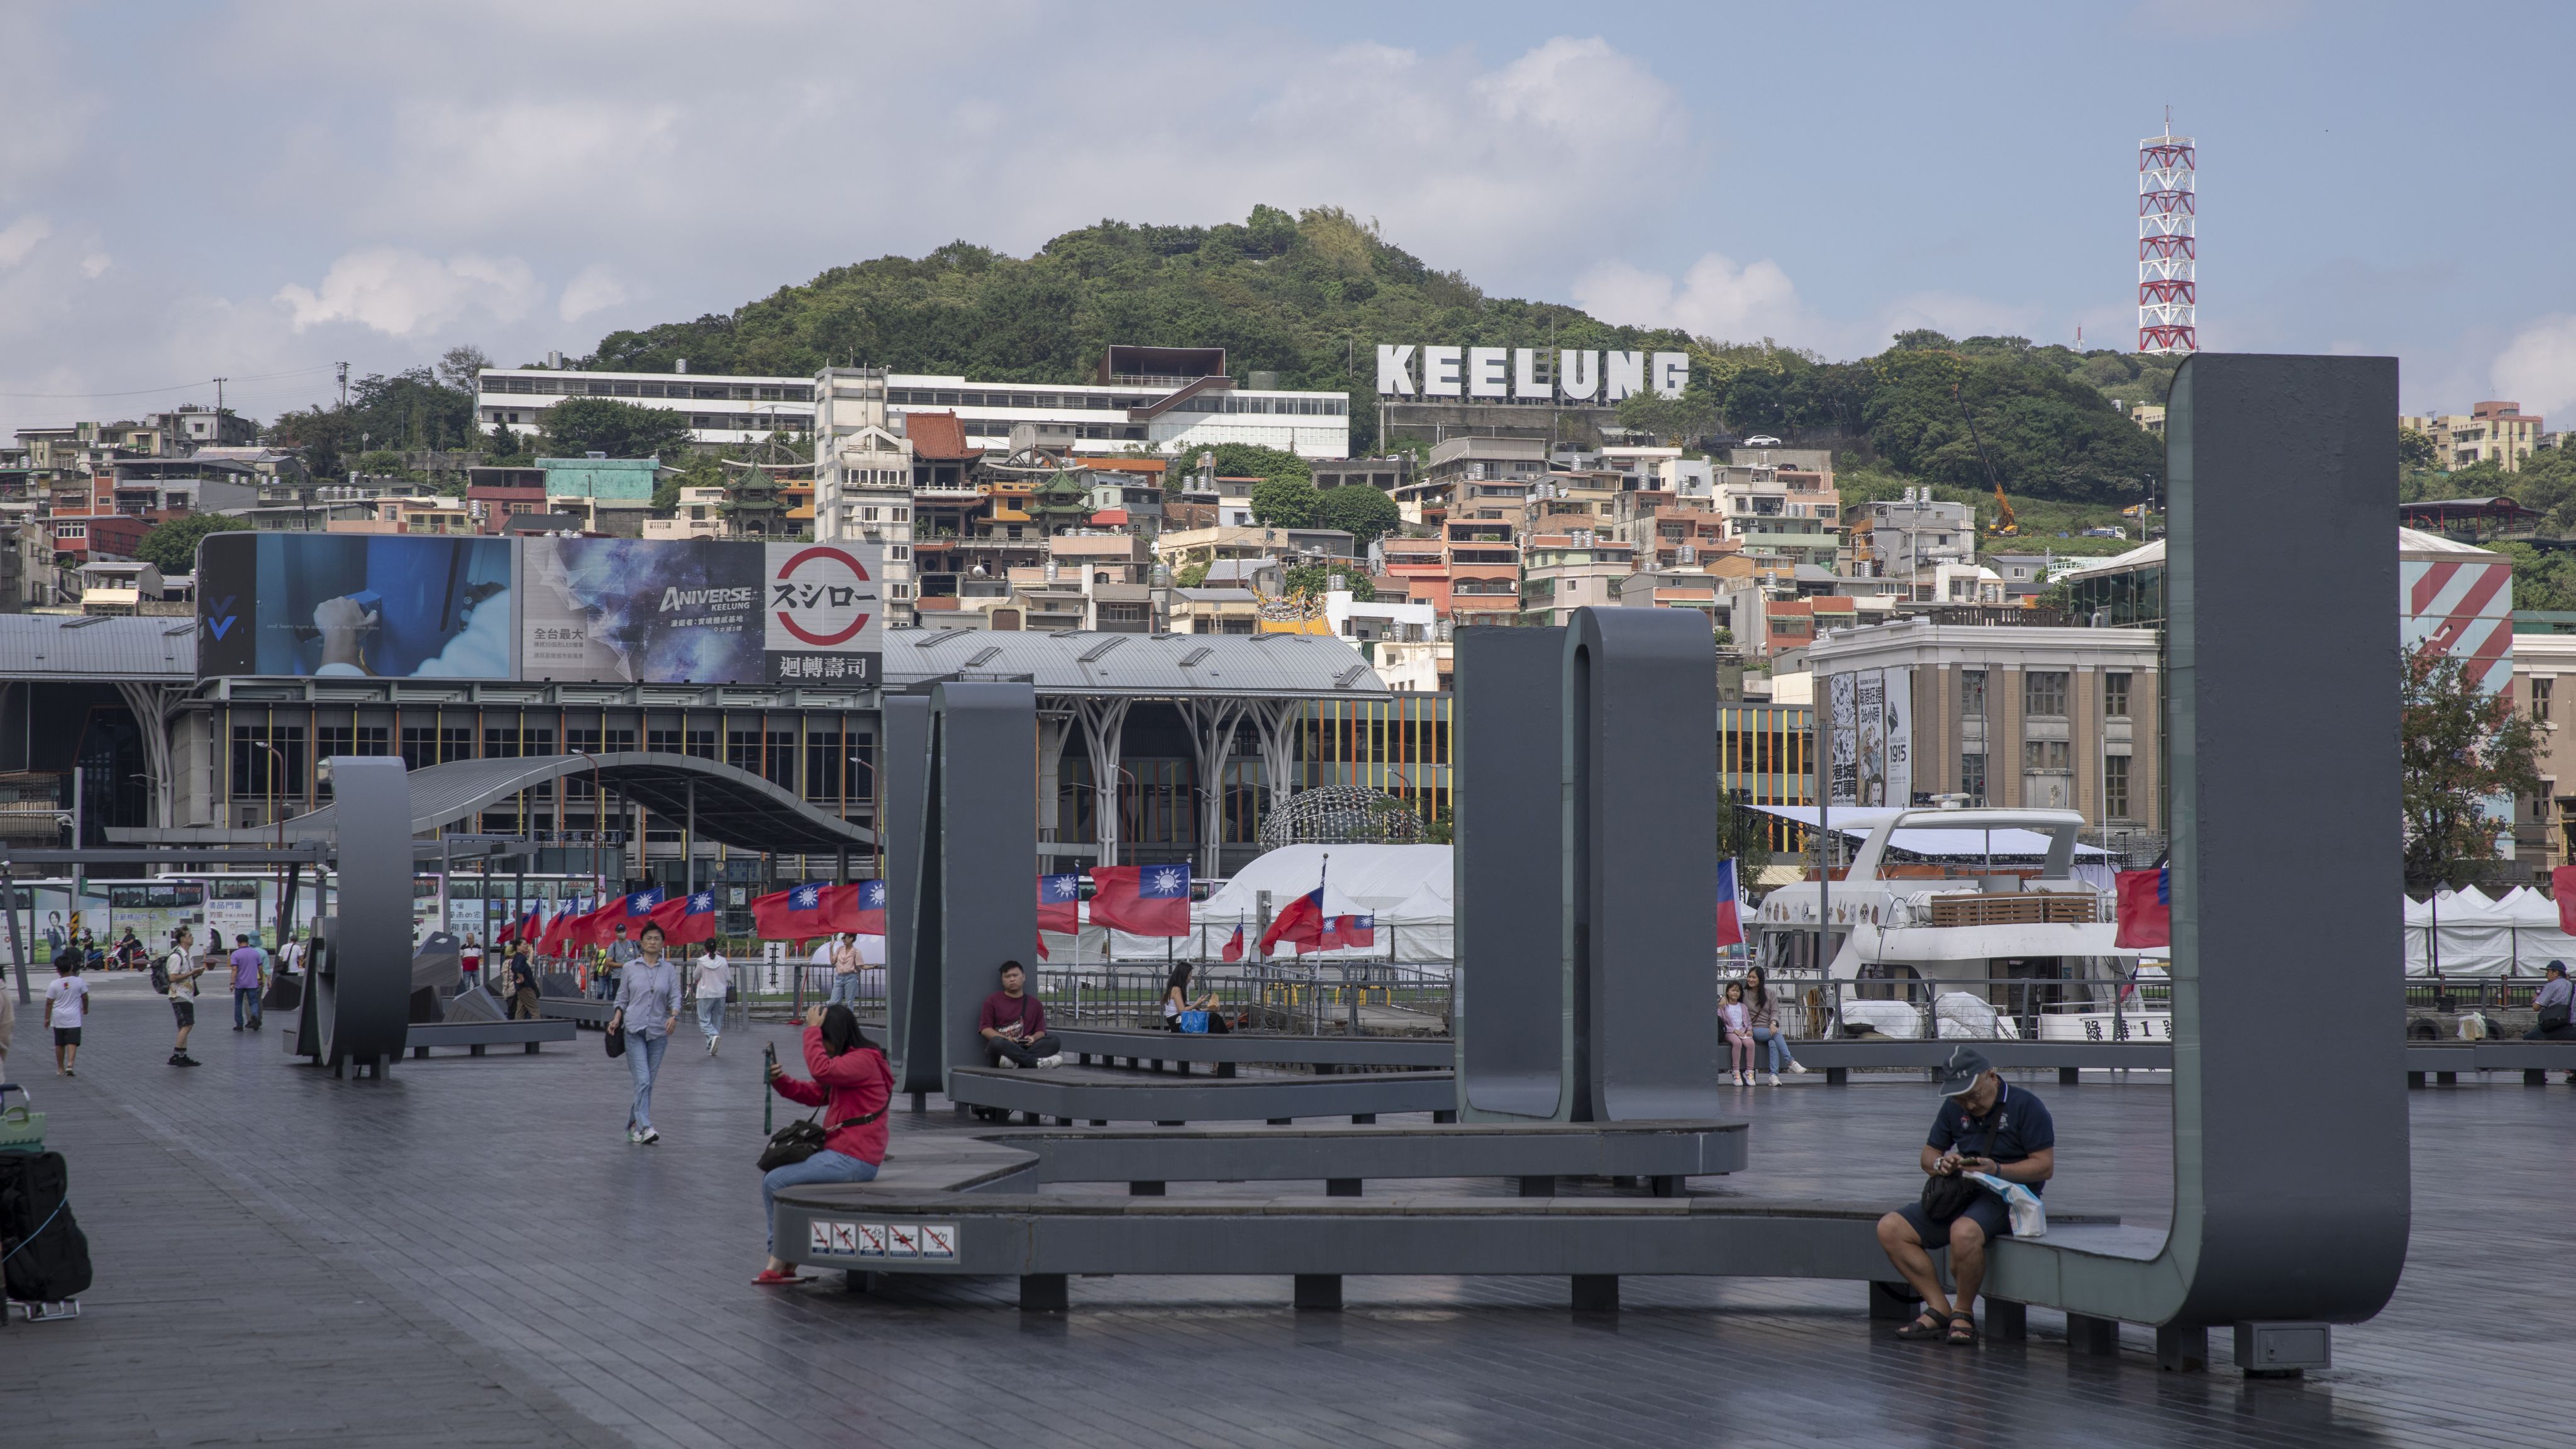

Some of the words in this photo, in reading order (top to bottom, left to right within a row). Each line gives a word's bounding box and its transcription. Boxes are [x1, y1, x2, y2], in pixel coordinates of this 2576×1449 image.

[1377, 344, 1690, 399] KEELUNG
[658, 586, 752, 612] ANIVERSE
[770, 583, 877, 609] スシロー
[711, 602, 750, 611] KEELUNG
[534, 628, 584, 640] 全台最大
[780, 656, 867, 678] 迴轉壽司
[1858, 686, 1882, 706] 海港狂搜
[1861, 706, 1880, 724] 26小時
[1890, 745, 1906, 763] 1915
[1833, 763, 1857, 780] 港城
[1832, 780, 1857, 797] 印事
